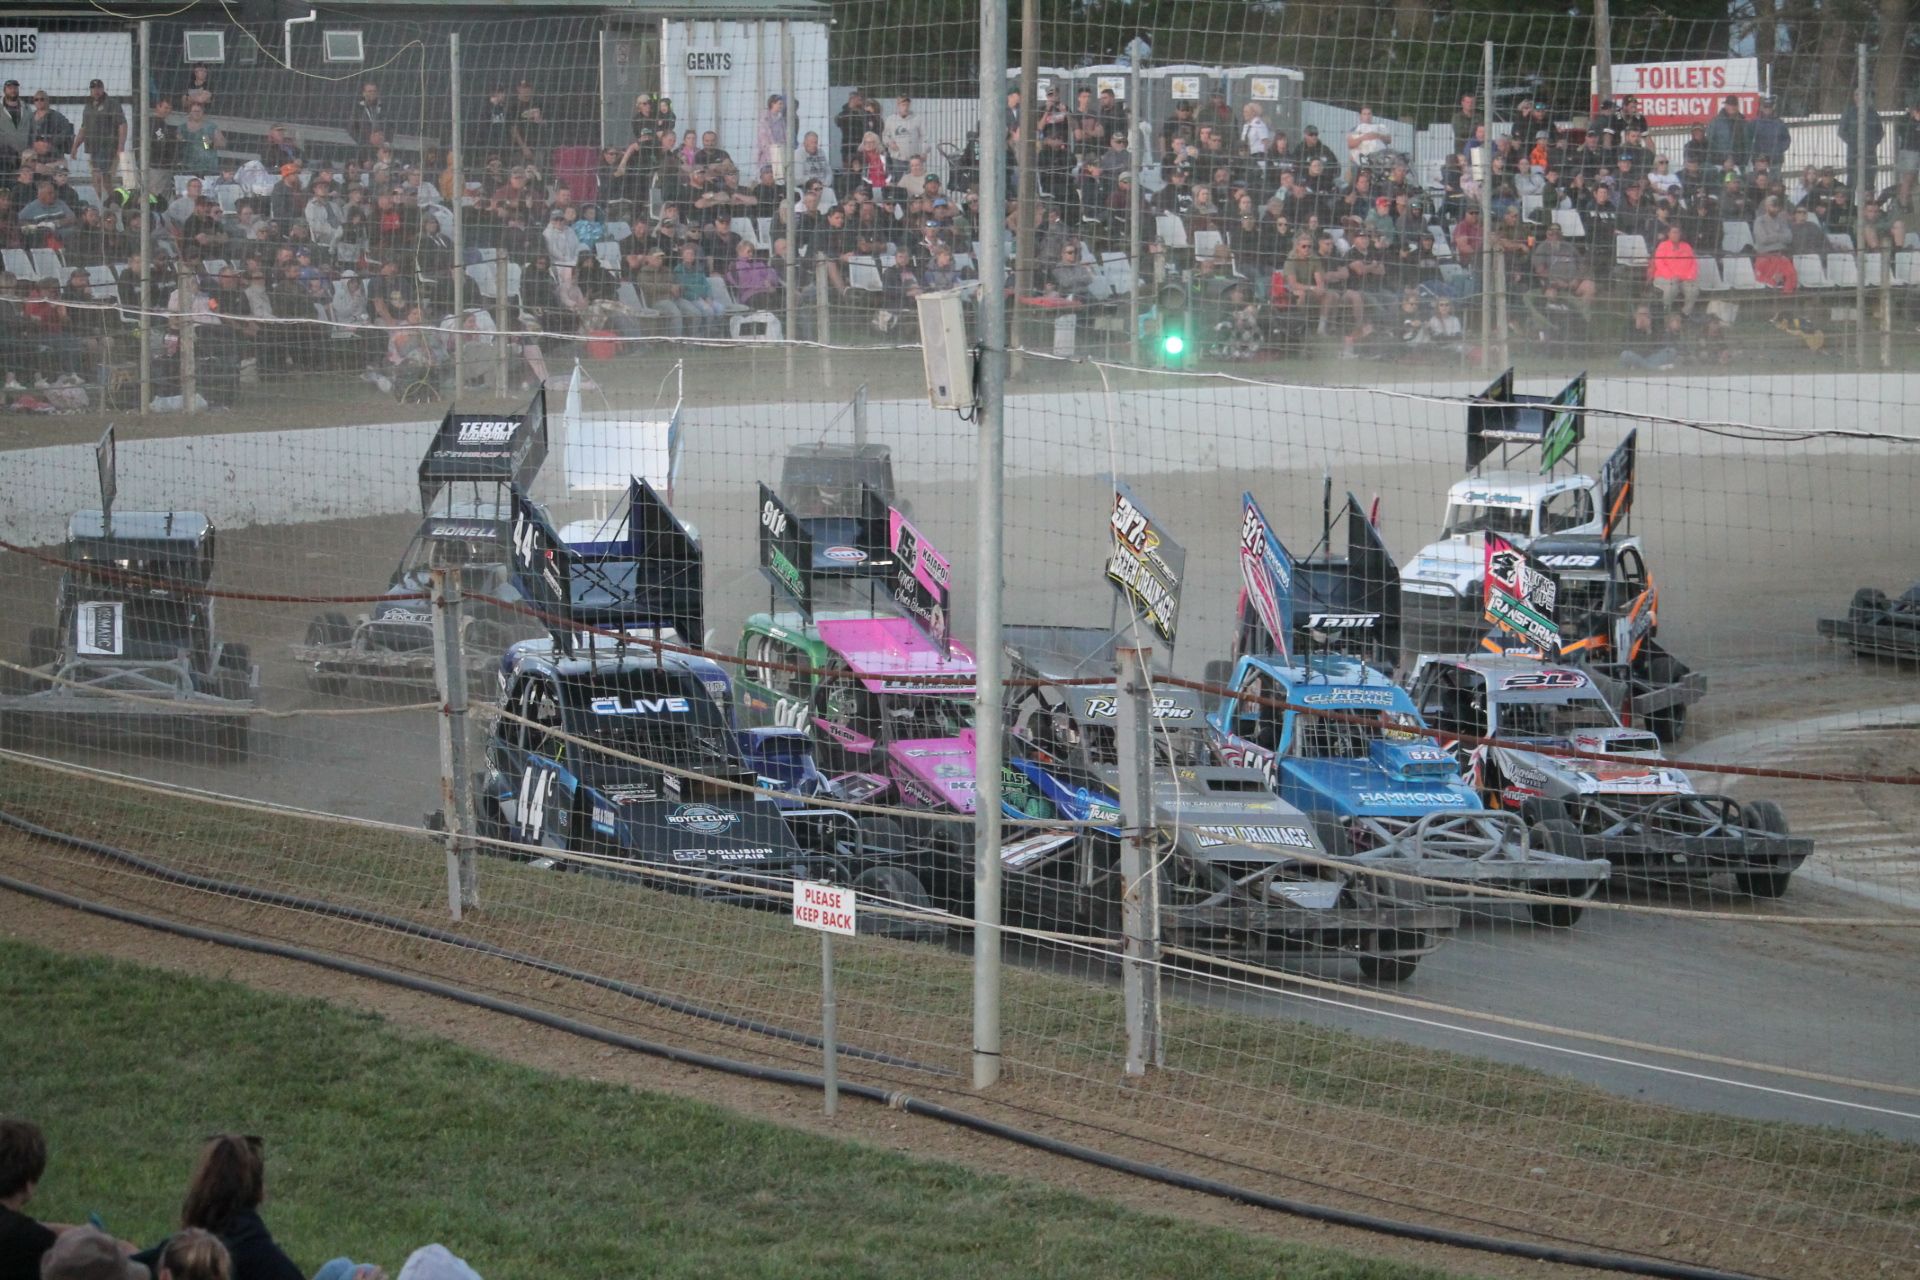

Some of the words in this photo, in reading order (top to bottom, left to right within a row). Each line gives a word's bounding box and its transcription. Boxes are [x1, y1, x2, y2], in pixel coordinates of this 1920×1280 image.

[687, 52, 731, 70] GENTS
[1635, 67, 1726, 89] TOILETS
[1717, 97, 1754, 115] EIT
[460, 422, 521, 436] TERRY
[431, 527, 497, 537] BONELL
[922, 548, 949, 582] KAIAPOI
[1488, 587, 1556, 644] TRANSFORM
[592, 698, 690, 713] CLIVE
[1358, 793, 1464, 802] HAMMONDS
[1239, 827, 1315, 849] DRAINAGE
[804, 888, 841, 909] PLEASE
[796, 906, 819, 923] KEEP
[822, 911, 851, 930] BACK
